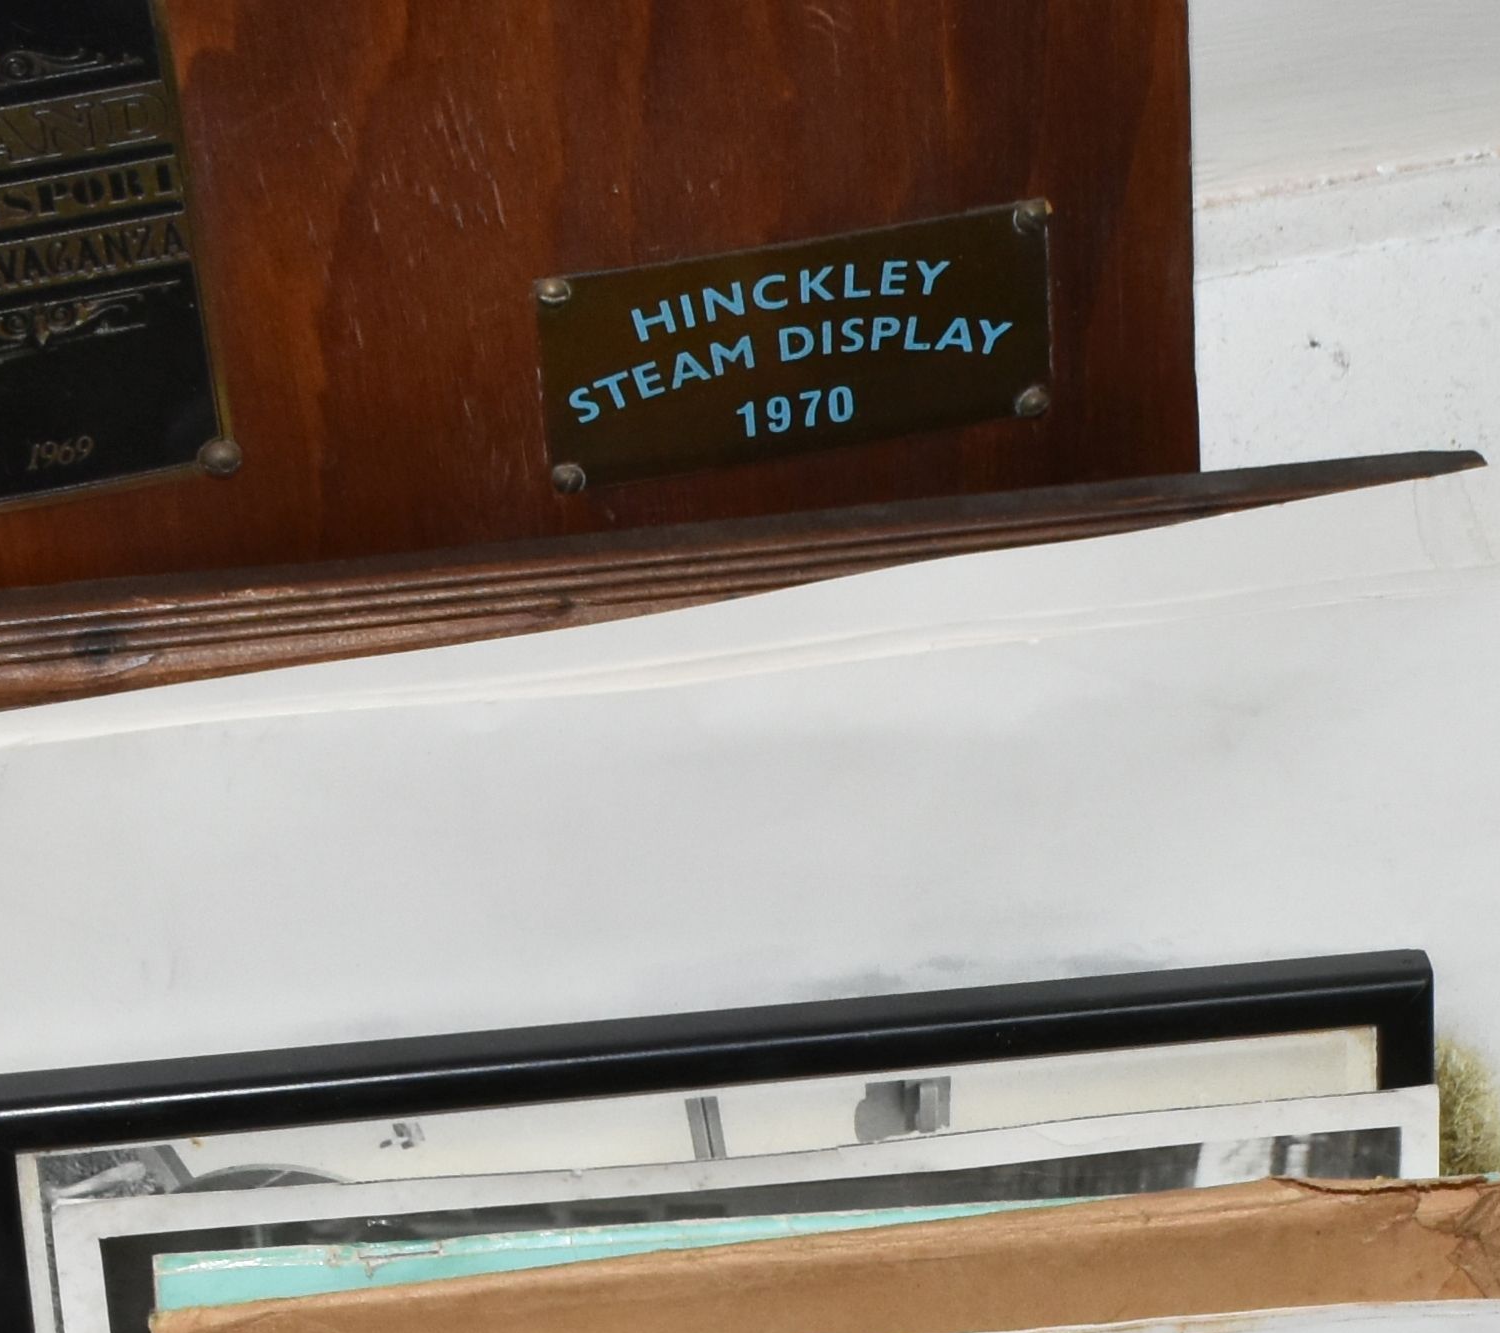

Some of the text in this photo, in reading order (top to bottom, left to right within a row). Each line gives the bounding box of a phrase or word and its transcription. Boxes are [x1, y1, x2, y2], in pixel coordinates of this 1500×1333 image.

[631, 260, 950, 342] HINCKLEY
[568, 315, 1013, 424] STEAM DISPLAY
[736, 385, 854, 438] 1970
[26, 436, 94, 471] 1969
